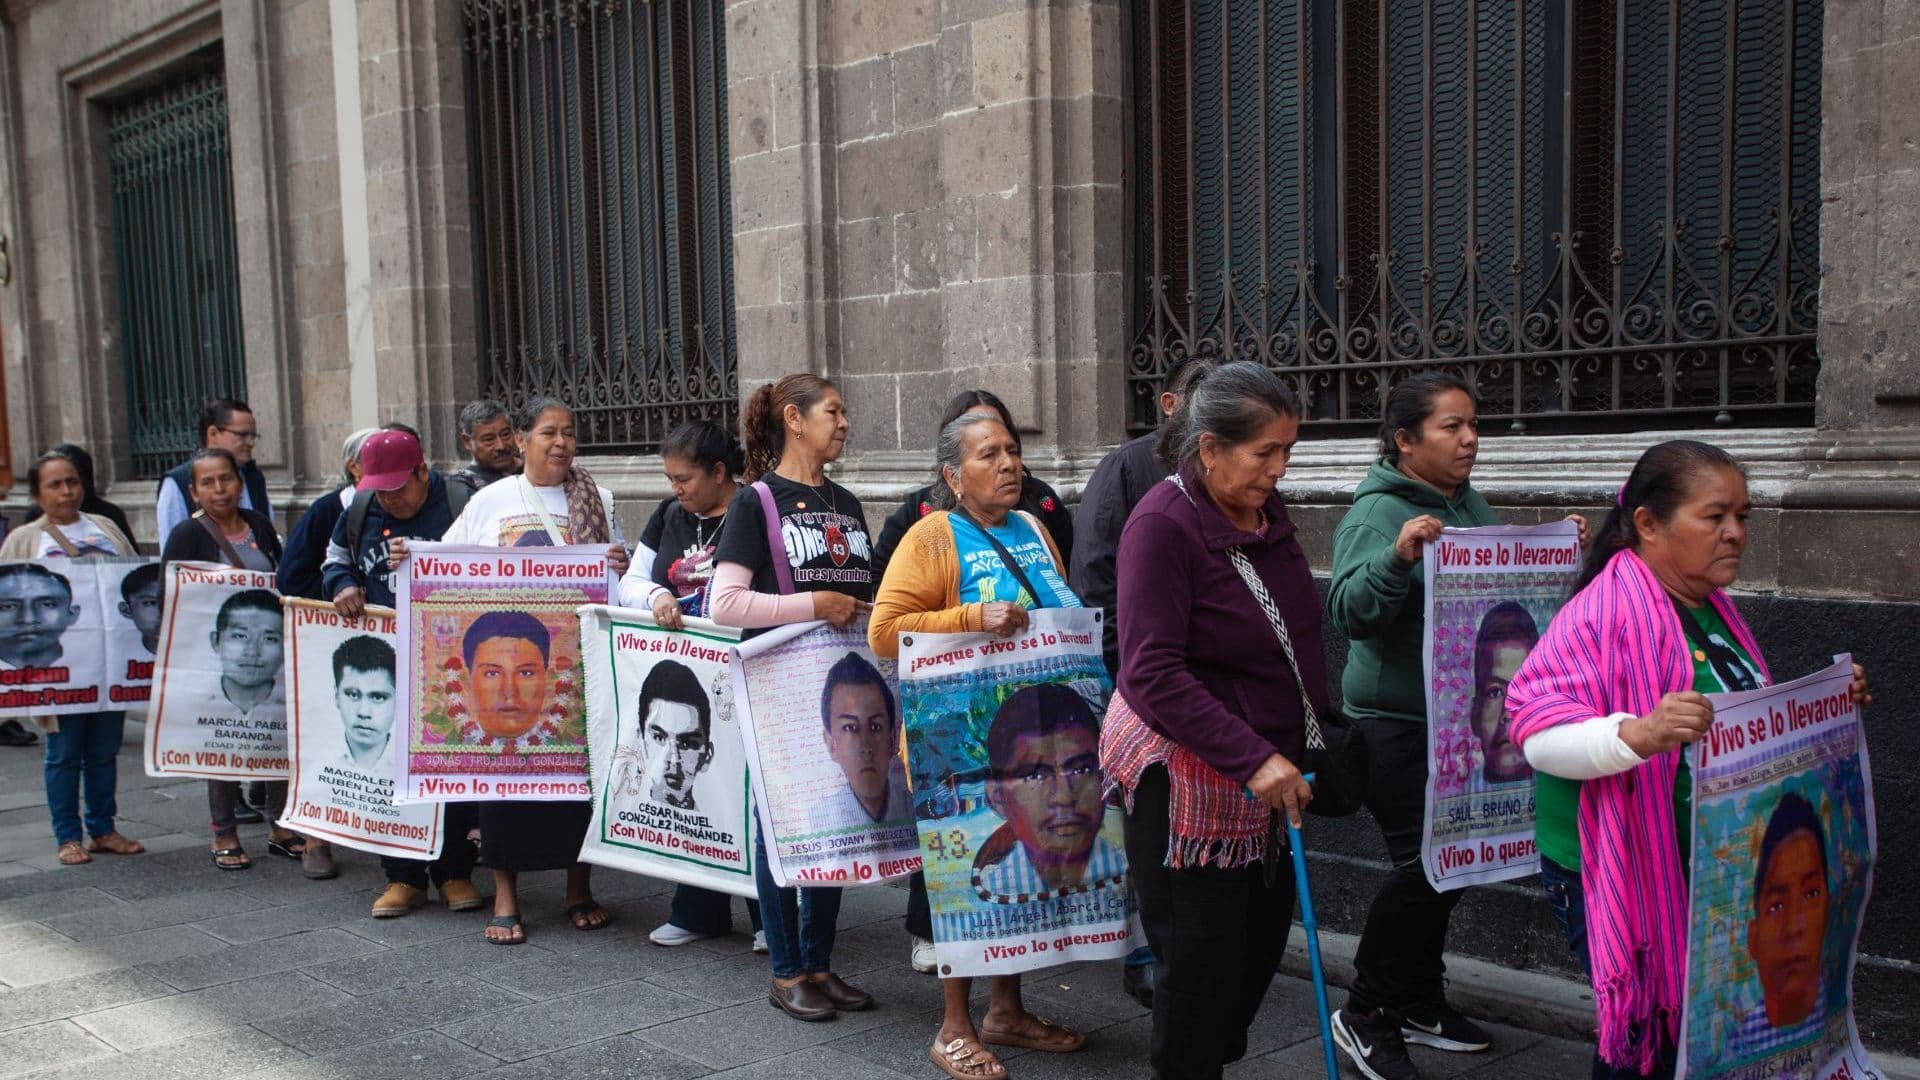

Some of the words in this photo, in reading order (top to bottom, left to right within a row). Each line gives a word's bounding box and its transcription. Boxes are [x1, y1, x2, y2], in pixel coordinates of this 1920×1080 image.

[833, 543, 845, 556] 43
[1436, 541, 1471, 573] ¡Vivo
[1474, 548, 1493, 566] se
[1496, 542, 1510, 566] lo
[1513, 542, 1578, 566] llevaron!
[413, 558, 462, 579] ¡Vivo
[468, 562, 492, 577] se
[498, 559, 515, 577] lo
[522, 559, 605, 578] llevaron!
[230, 574, 246, 585] se
[252, 573, 265, 588] lo
[298, 608, 338, 626] ¡Vivo
[342, 615, 358, 629] se
[617, 633, 648, 651] ¡Vivo
[650, 639, 662, 652] se
[665, 636, 678, 653] lo
[911, 645, 975, 673] ¡Porque
[979, 640, 1016, 656] vivo
[1021, 636, 1038, 650] se
[1042, 632, 1057, 646] lo
[197, 717, 251, 728] MARCIAL
[1701, 721, 1744, 768] ¡Vivo
[1748, 716, 1766, 745] se
[1768, 705, 1784, 738] lo
[1787, 684, 1853, 732] llevaron!
[214, 729, 273, 741] BARANDA
[204, 741, 234, 749] EDAD
[254, 742, 283, 751] AÑOS
[162, 750, 190, 766] ¡Con
[196, 752, 227, 767] VIDA
[230, 753, 242, 768] lo
[426, 755, 462, 767] JONAS
[469, 755, 527, 767] TRUJILLO
[318, 775, 361, 791] RUBÉN
[419, 778, 466, 797] ¡Vivo
[473, 779, 490, 795] lo
[331, 797, 355, 808] EDAD
[358, 803, 368, 811] 19
[371, 805, 400, 817] AÑOS
[638, 802, 672, 820] CÉSAR
[1483, 798, 1521, 819] BRUNO
[299, 801, 321, 818] ¡Con
[326, 806, 349, 826] VIDA
[352, 812, 361, 829] lo
[364, 818, 428, 841] queremos!
[618, 811, 672, 831] GONZÁLEZ
[674, 822, 734, 845] HERNÁNDEZ
[610, 823, 635, 838] ¡Con
[637, 826, 665, 846] VIDA
[667, 833, 680, 848] lo
[682, 840, 741, 862] queremos!
[791, 841, 822, 855] JESÚS
[829, 834, 866, 849] JOVANY
[1438, 845, 1475, 877] ¡Vivo
[1481, 841, 1495, 863] lo
[853, 860, 872, 880] lo
[1056, 900, 1100, 916] Abarca
[986, 928, 996, 937] de
[984, 944, 1027, 963] ¡Vivo
[1031, 939, 1050, 953] lo
